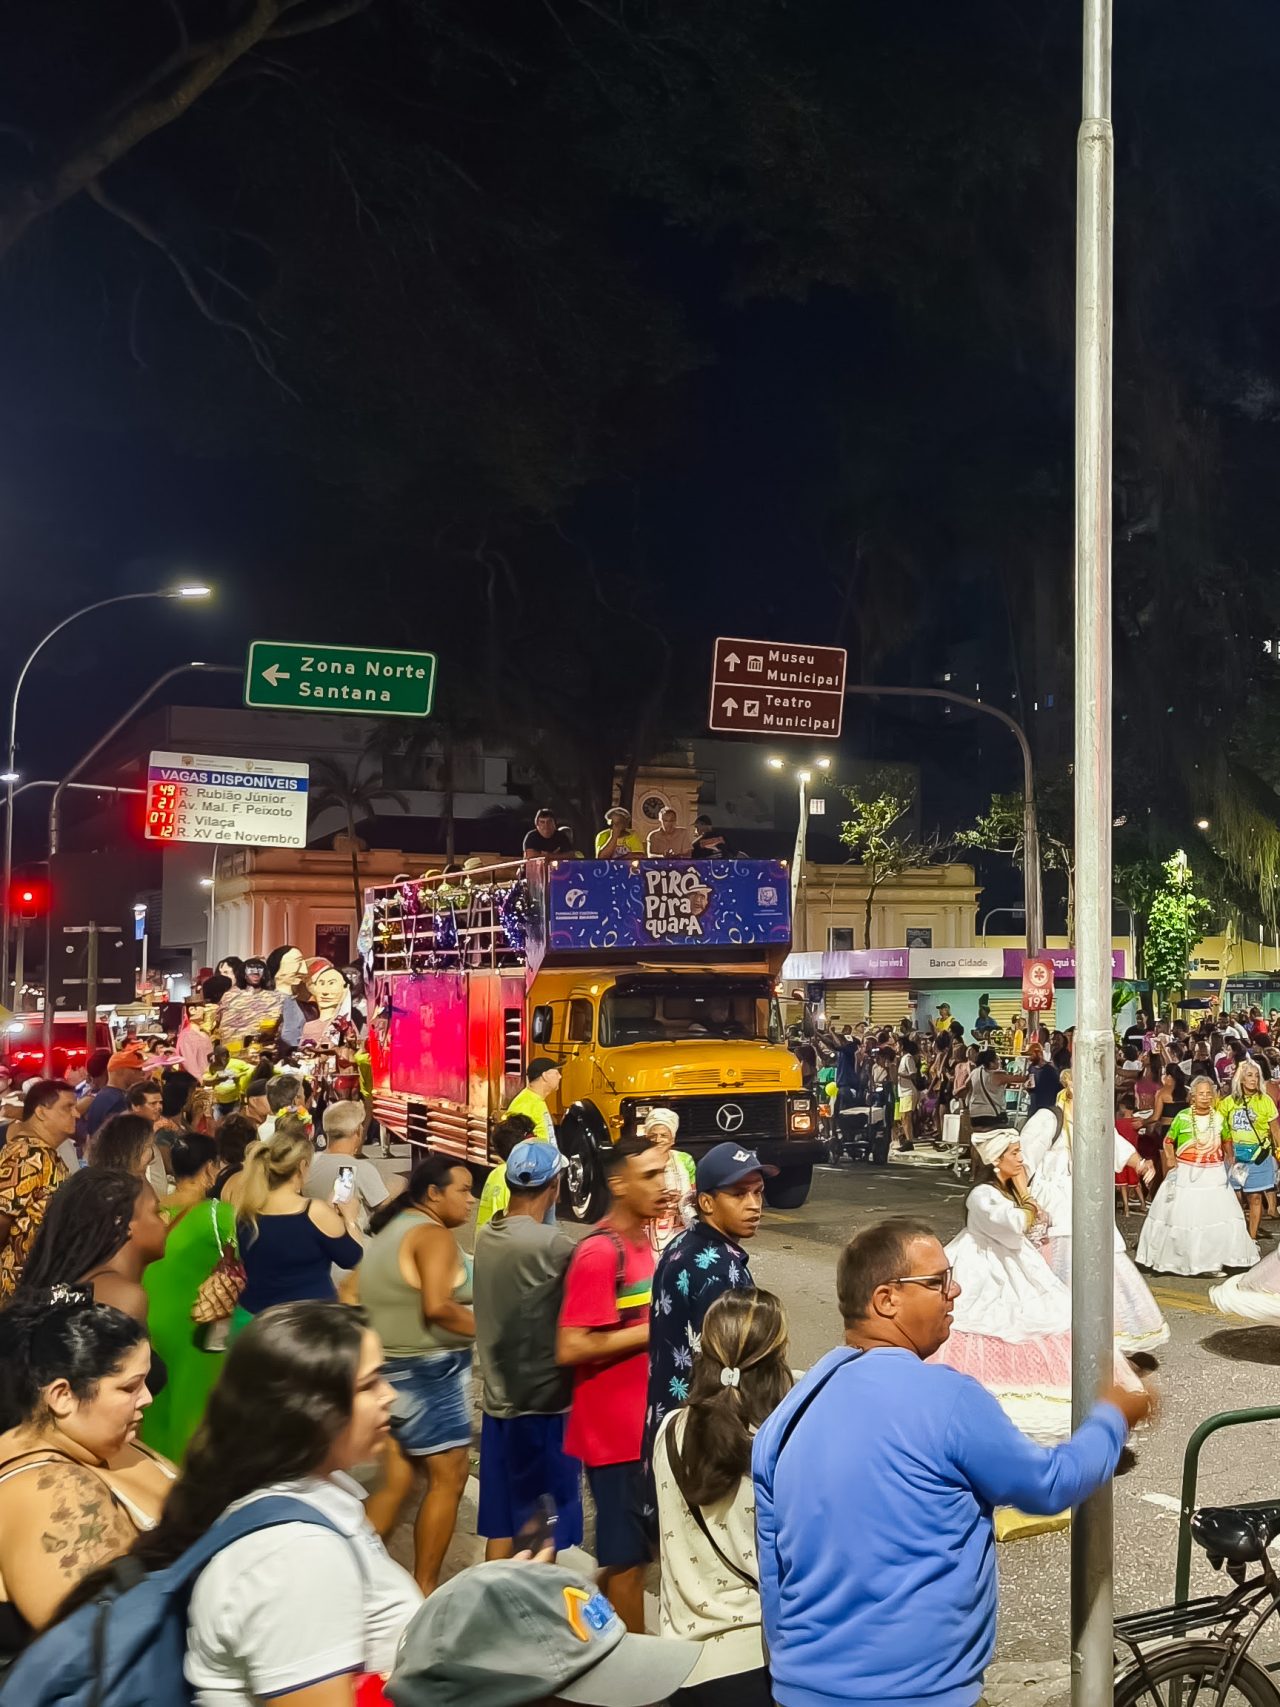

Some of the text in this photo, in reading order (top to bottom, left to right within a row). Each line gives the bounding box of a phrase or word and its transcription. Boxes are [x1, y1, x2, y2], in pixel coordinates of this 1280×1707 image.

[768, 650, 815, 665] Museu
[300, 656, 426, 679] Zona Norte
[767, 669, 839, 687] Municipal
[299, 682, 391, 702] Santana
[765, 694, 812, 709] Teatro
[763, 713, 836, 731] Municipal
[160, 769, 298, 790] VAGAS DISPONÍVEIS
[179, 787, 192, 797] R.
[196, 788, 242, 800] Rubião
[178, 801, 198, 811] Av.
[202, 801, 226, 812] Mal.
[232, 803, 242, 814] F.
[246, 804, 293, 817] Peixoto
[177, 814, 191, 825] R.
[194, 815, 235, 829] Vilaça
[176, 828, 190, 838] R.
[194, 828, 212, 839] XV
[215, 829, 232, 841] de
[235, 830, 300, 845] Novembro
[929, 958, 988, 968] Banca Cidade
[1027, 996, 1048, 1008] 192
